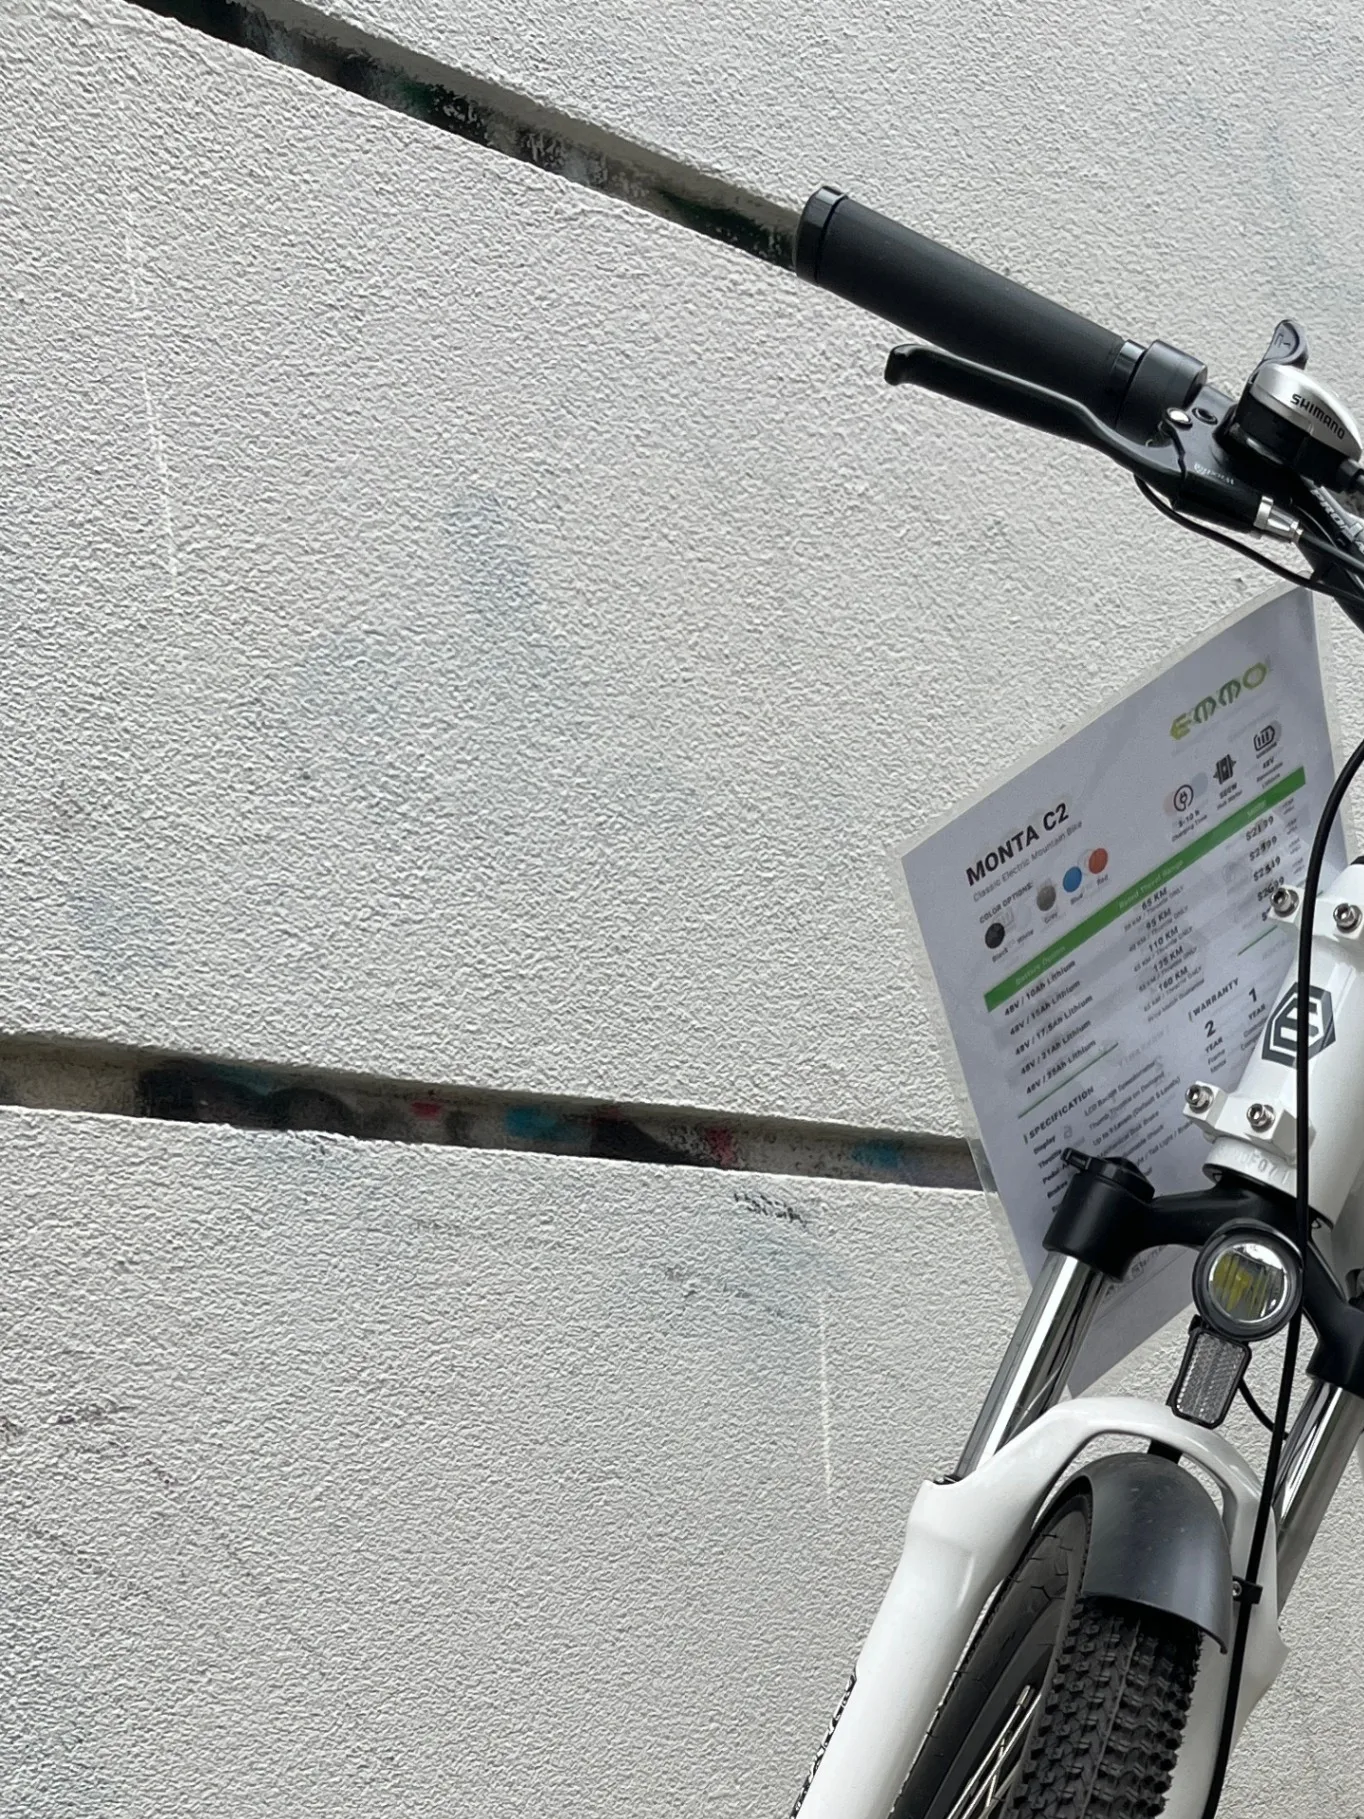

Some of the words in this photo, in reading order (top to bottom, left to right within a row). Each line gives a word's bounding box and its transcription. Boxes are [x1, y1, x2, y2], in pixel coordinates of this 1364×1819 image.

[1290, 393, 1346, 440] SHIMANO
[1170, 661, 1267, 741] EMMO
[965, 825, 1038, 885] MONTA
[1042, 801, 1068, 832] C2
[973, 877, 1000, 903] Classic
[1002, 856, 1029, 882] Electric
[1031, 831, 1065, 861] Mountain
[1067, 819, 1082, 836] Bike
[979, 903, 1001, 924] COLOR
[1154, 887, 1166, 901] KM
[1158, 907, 1170, 921] KM
[1149, 936, 1163, 951] 110
[1165, 925, 1177, 940] KM
[1170, 945, 1182, 960] KM
[1004, 1000, 1019, 1016] 48V
[1047, 959, 1075, 984] Lithium
[1159, 976, 1172, 991] 160
[1175, 965, 1187, 980] KM
[1193, 978, 1238, 1016] WARRANTY
[1010, 1020, 1024, 1036] 48V
[1051, 978, 1080, 1004] Lithium
[1015, 1039, 1030, 1055] 48V
[1064, 993, 1092, 1019] Lithium
[1204, 1018, 1215, 1038] 2
[1248, 987, 1256, 1003] 1
[1205, 1036, 1222, 1053] YEAR
[1248, 1003, 1265, 1020] YEAR
[1021, 1059, 1035, 1075] 48V
[1062, 1018, 1090, 1044] Lithium
[1026, 1078, 1041, 1094] 48V
[1067, 1038, 1095, 1063] Lithium
[1029, 1086, 1093, 1138] SPECIFICATION
[1084, 1103, 1096, 1116] LCD
